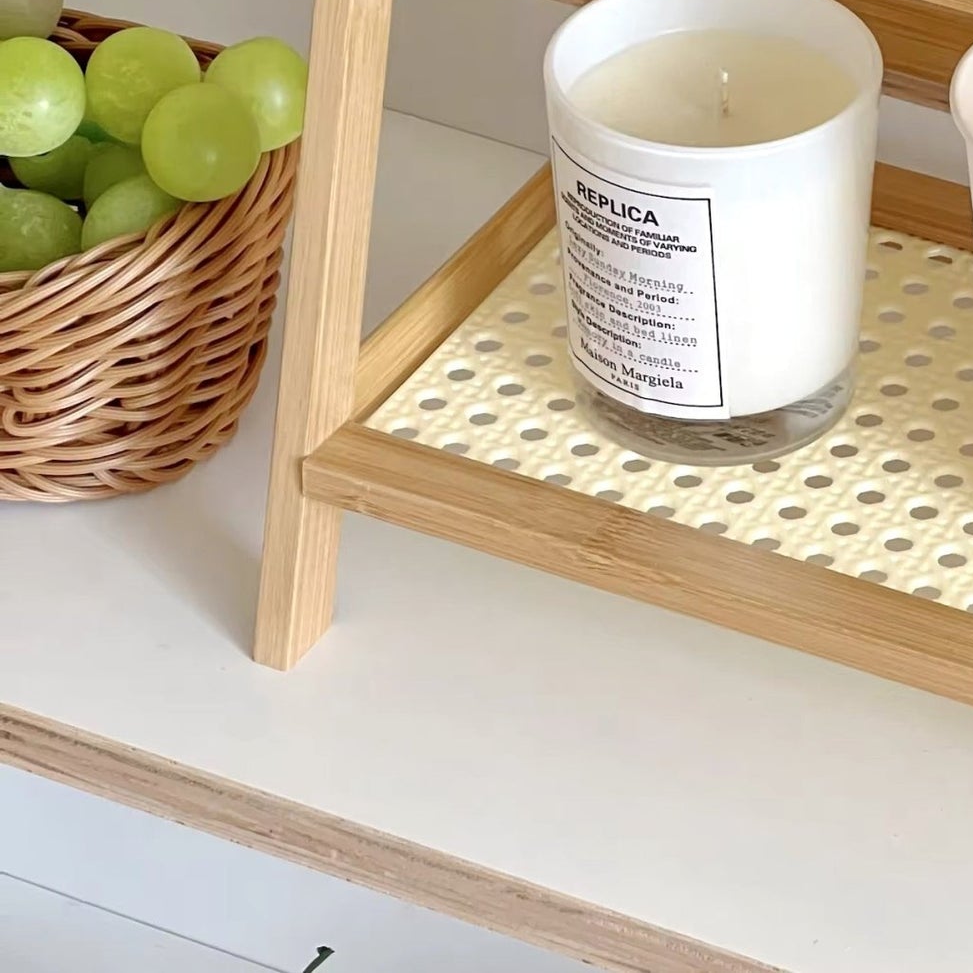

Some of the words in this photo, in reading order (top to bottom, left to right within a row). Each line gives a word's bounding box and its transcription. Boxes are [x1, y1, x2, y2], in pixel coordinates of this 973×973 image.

[575, 180, 659, 227] REPLICA
[595, 220, 638, 244] MOMENTS
[639, 237, 653, 248] OF
[653, 240, 697, 254] VARYING
[621, 225, 633, 235] OF
[634, 227, 680, 244] FAMILIAR
[611, 236, 630, 250] AND
[630, 244, 672, 260] PERIODS
[629, 270, 685, 292] Morning
[614, 282, 634, 295] and
[636, 289, 680, 305] Period:
[608, 303, 676, 331] Description:
[586, 315, 642, 349] Description:
[634, 326, 656, 338] bed
[661, 332, 698, 345] linen
[639, 352, 682, 368] candle
[610, 373, 640, 391] PARIS
[621, 363, 684, 390] Margiela
